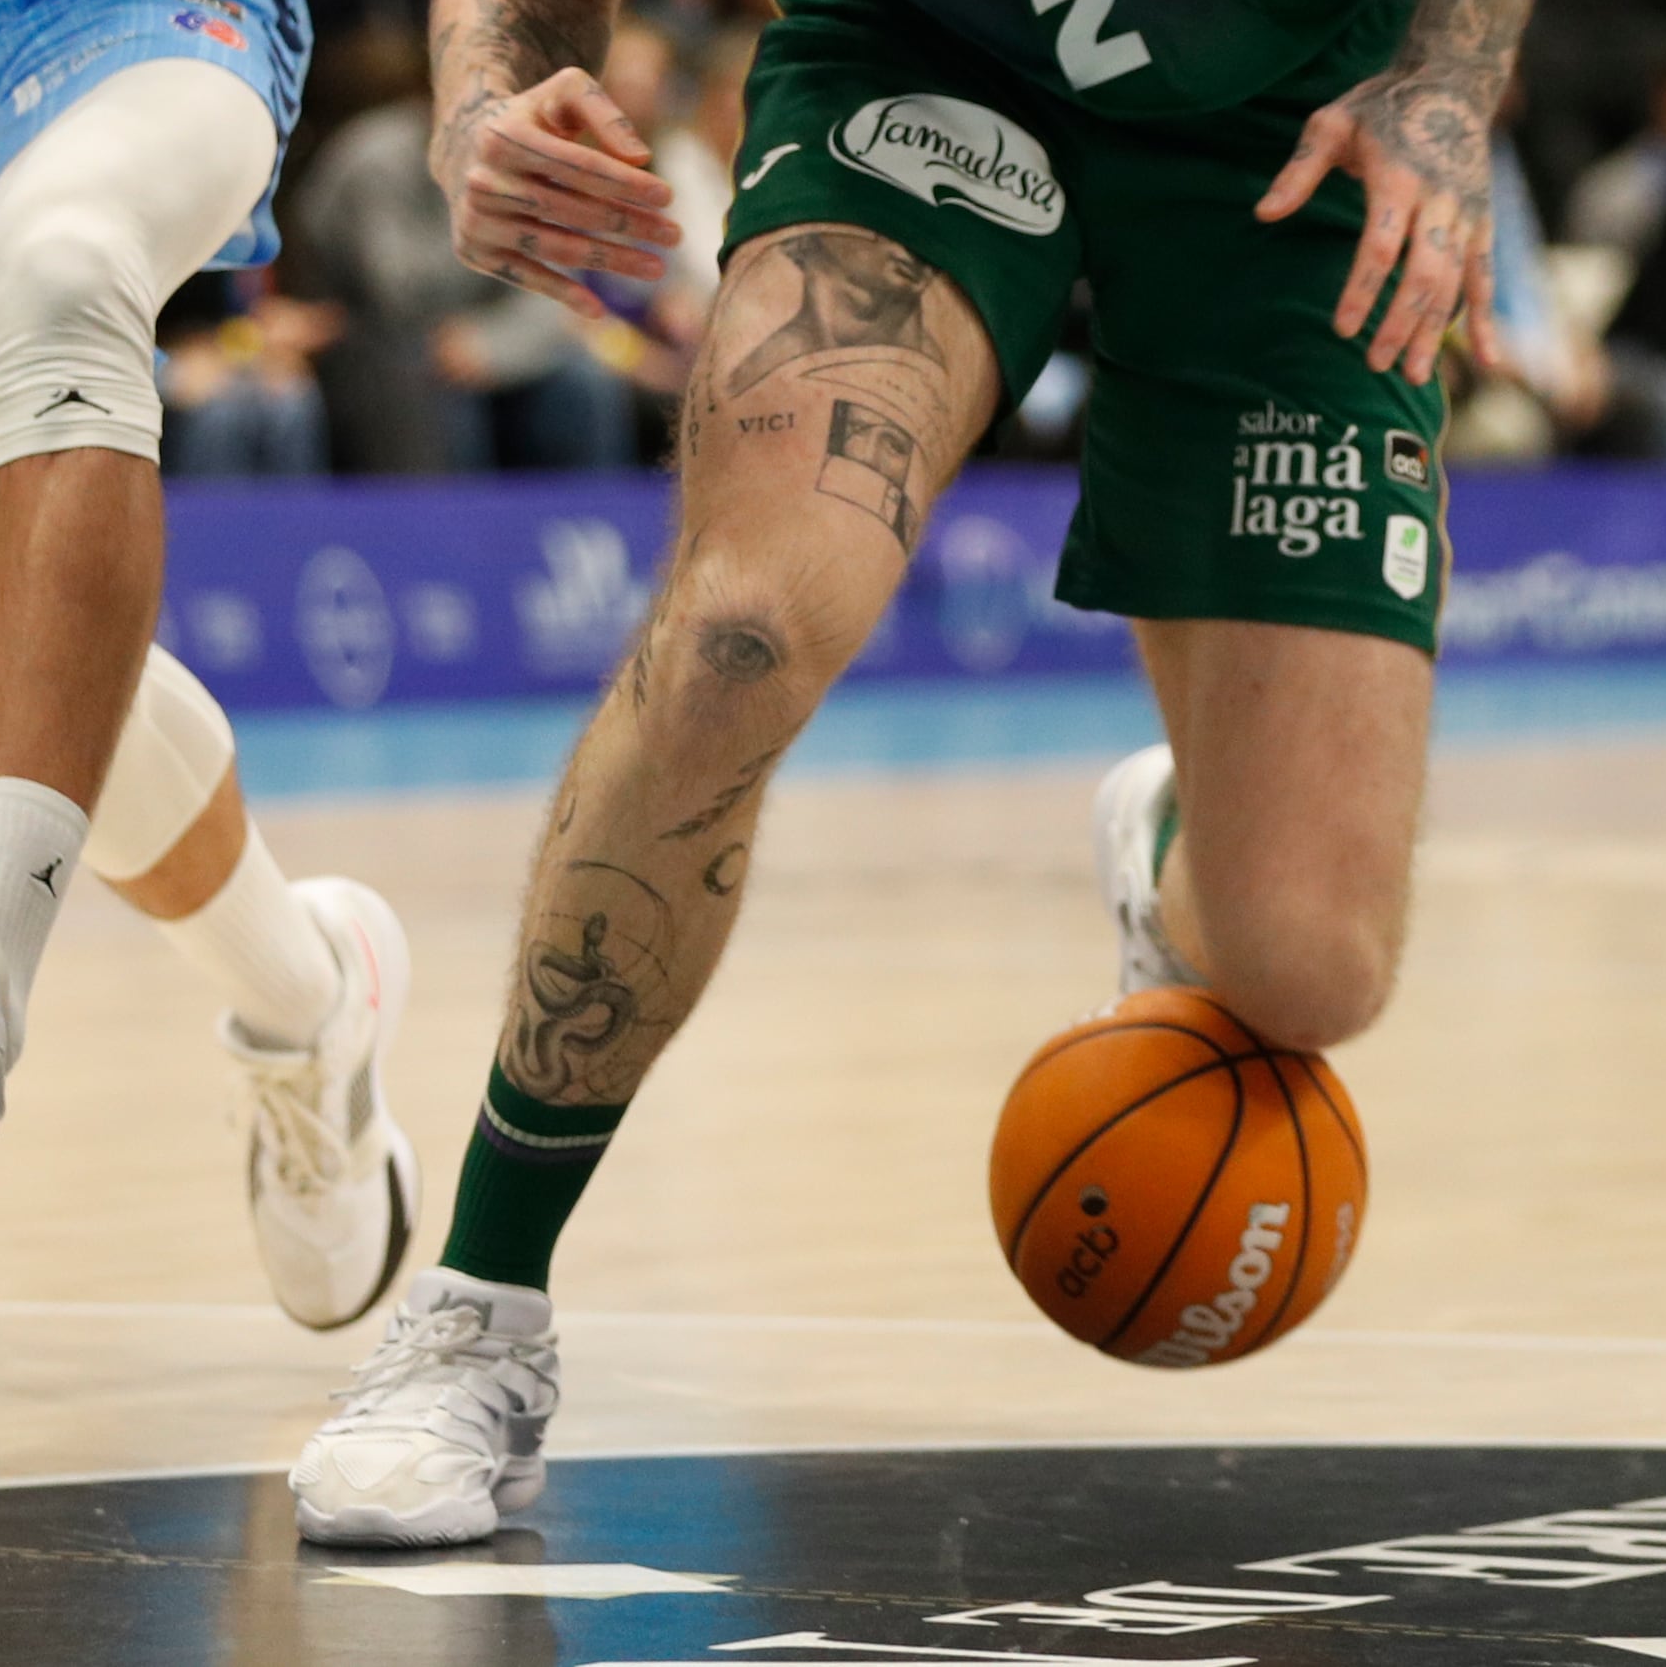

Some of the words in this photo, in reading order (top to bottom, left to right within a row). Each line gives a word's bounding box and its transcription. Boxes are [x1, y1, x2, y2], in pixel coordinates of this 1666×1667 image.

[856, 100, 1060, 212] famadesa
[738, 412, 795, 434] VICI
[1237, 399, 1323, 434] sabor
[1251, 424, 1369, 491] má
[1229, 475, 1367, 559] laga
[1056, 1223, 1120, 1298] acb
